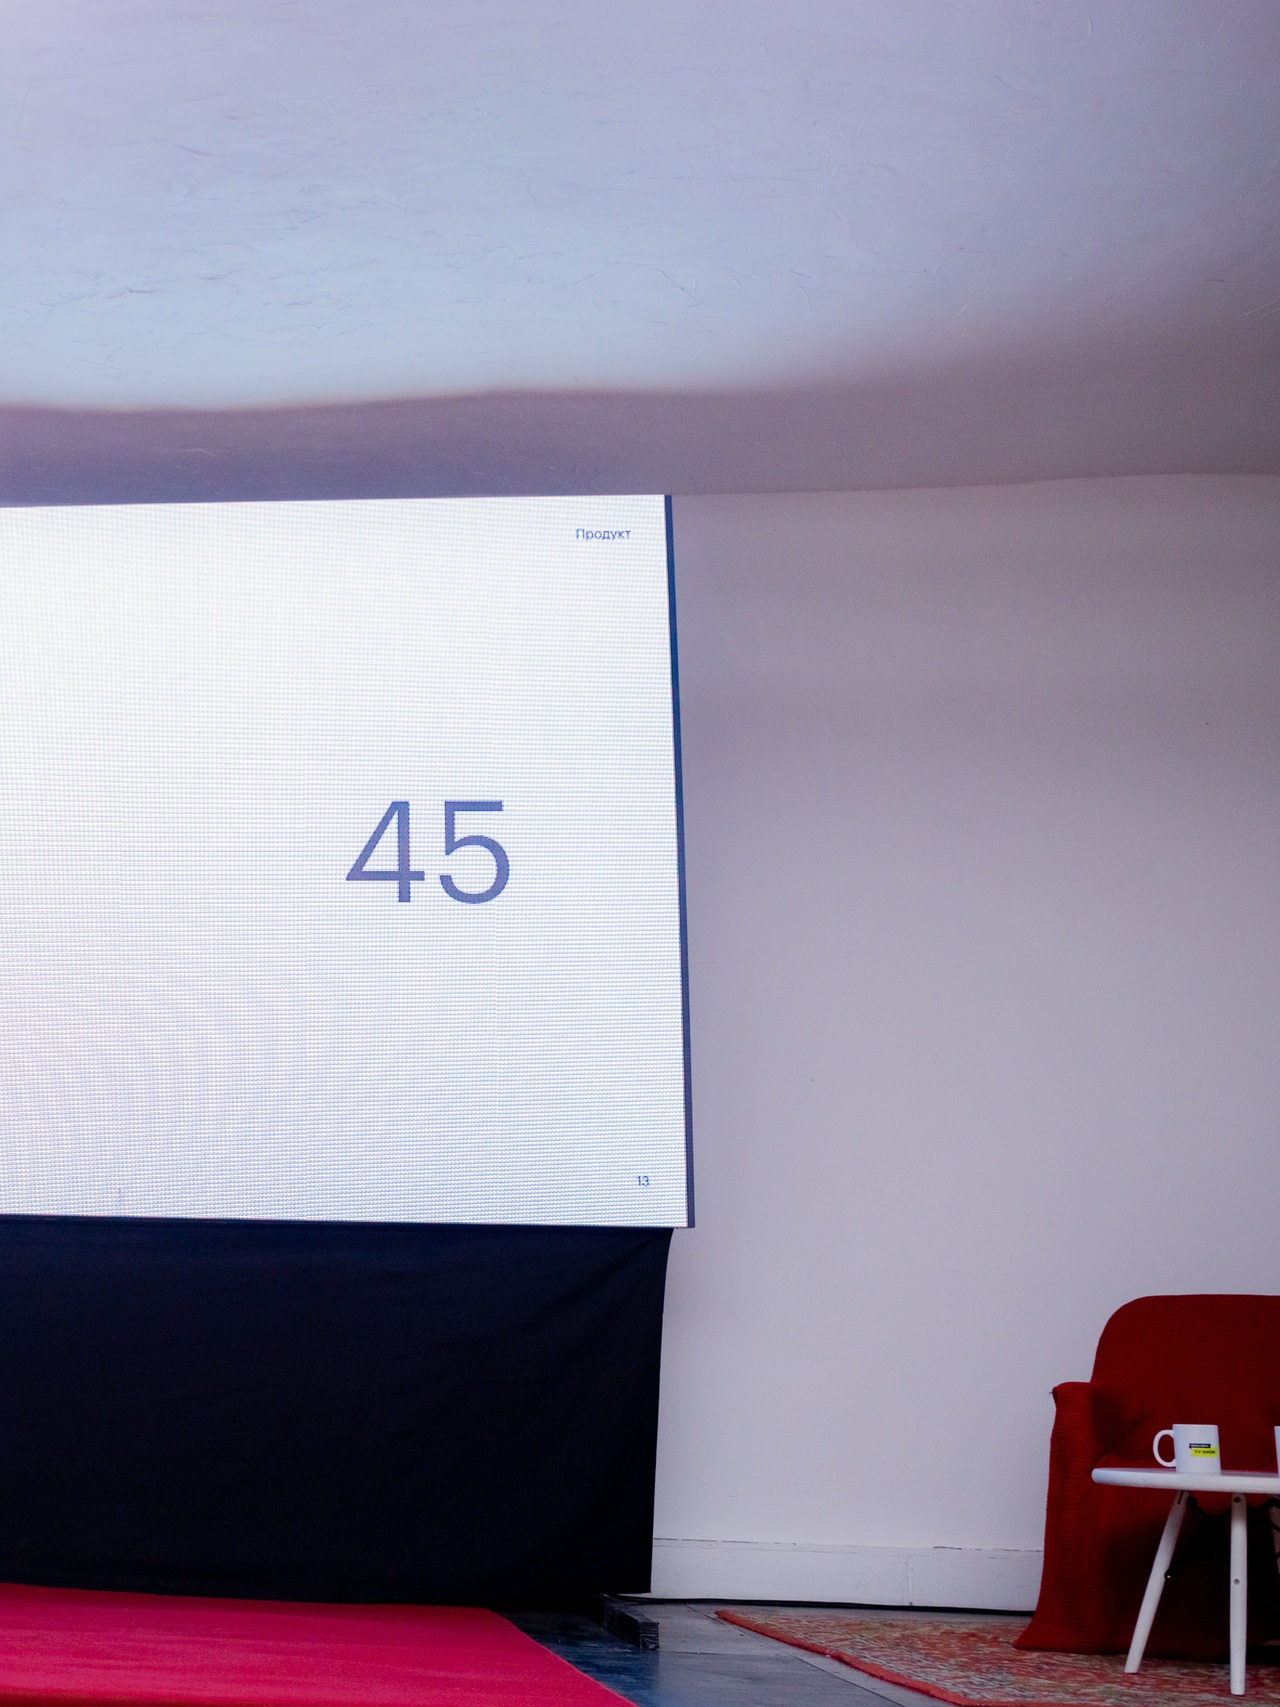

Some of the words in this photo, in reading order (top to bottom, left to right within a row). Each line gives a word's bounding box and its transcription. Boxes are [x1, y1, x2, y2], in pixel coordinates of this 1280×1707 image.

[575, 528, 632, 541] Продукт
[345, 800, 510, 904] 45
[637, 1175, 650, 1187] 13
